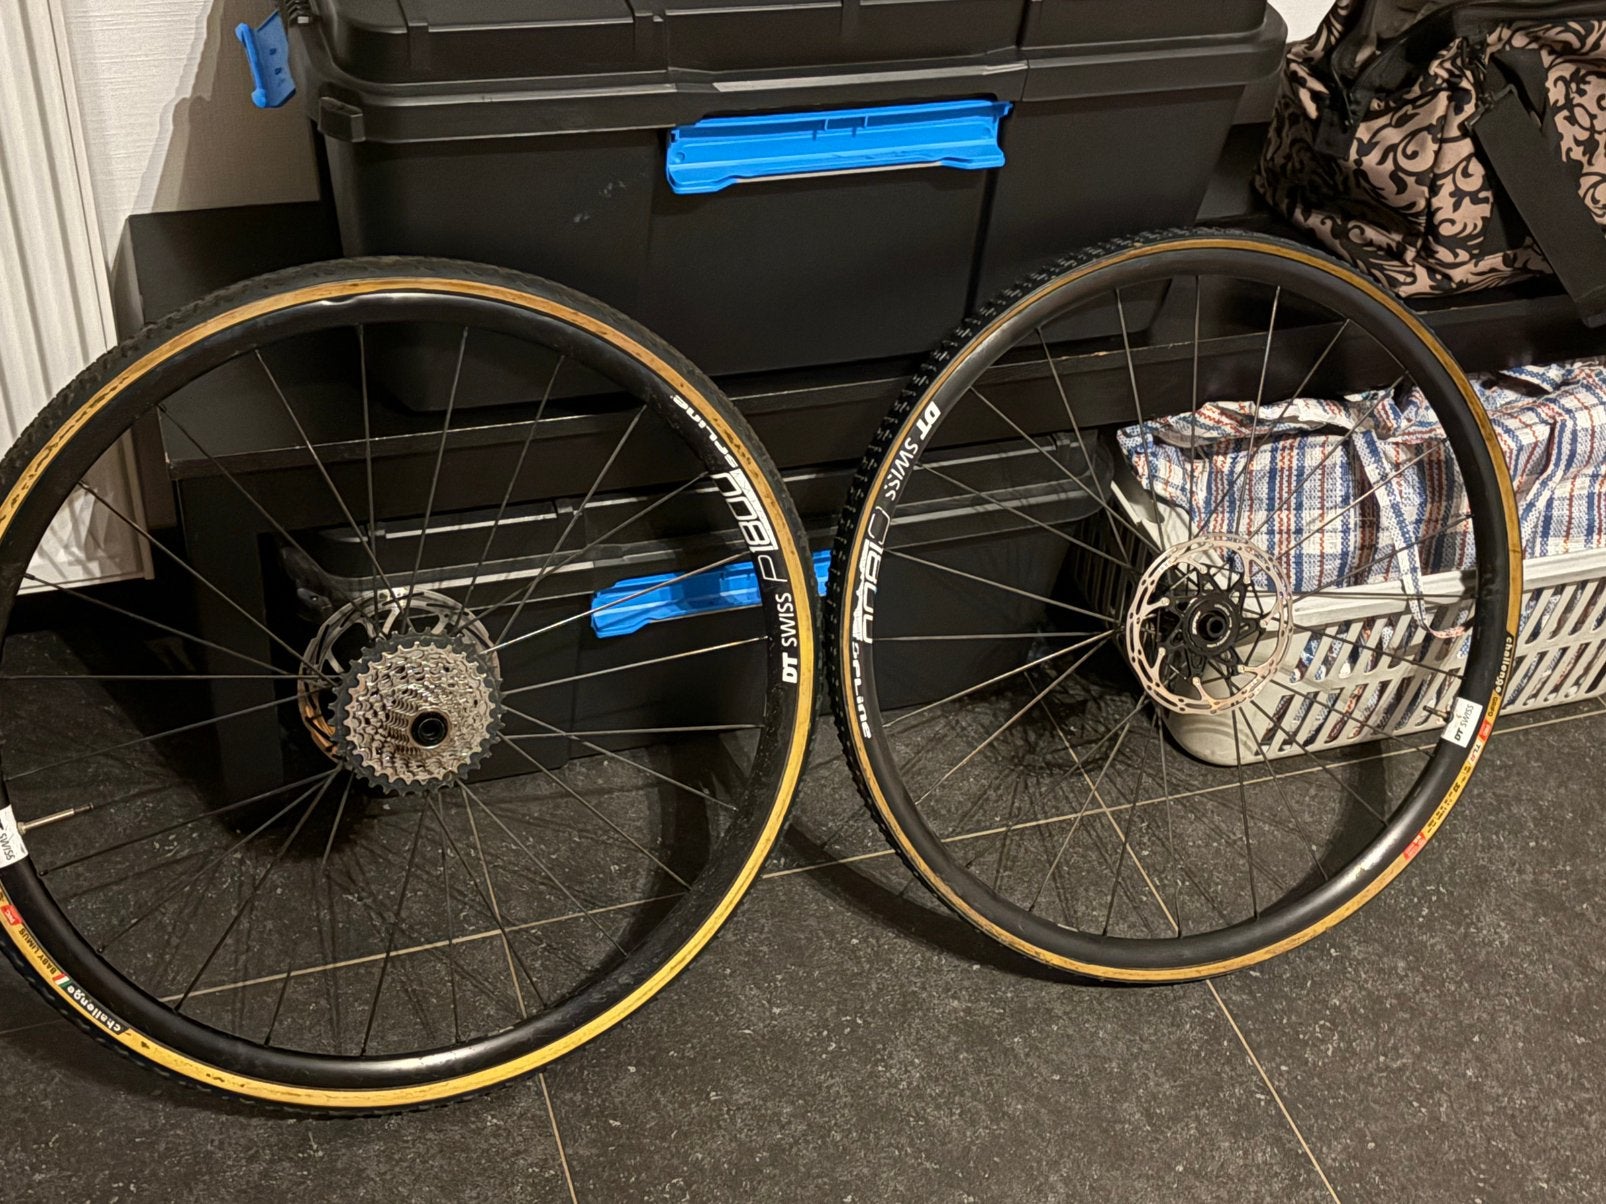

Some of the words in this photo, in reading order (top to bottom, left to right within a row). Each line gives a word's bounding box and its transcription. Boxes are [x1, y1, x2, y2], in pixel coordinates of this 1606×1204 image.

[916, 401, 941, 440] DT
[884, 437, 918, 501] SWISS
[775, 592, 798, 647] SWISS
[782, 652, 798, 684] DT
[1494, 636, 1513, 694] challenge
[1454, 729, 1464, 742] DT
[1460, 704, 1474, 728] SWISS
[0, 832, 15, 860] SWISS
[18, 927, 40, 954] LIMUS
[38, 953, 58, 975] BABY
[67, 985, 121, 1032] challenge
